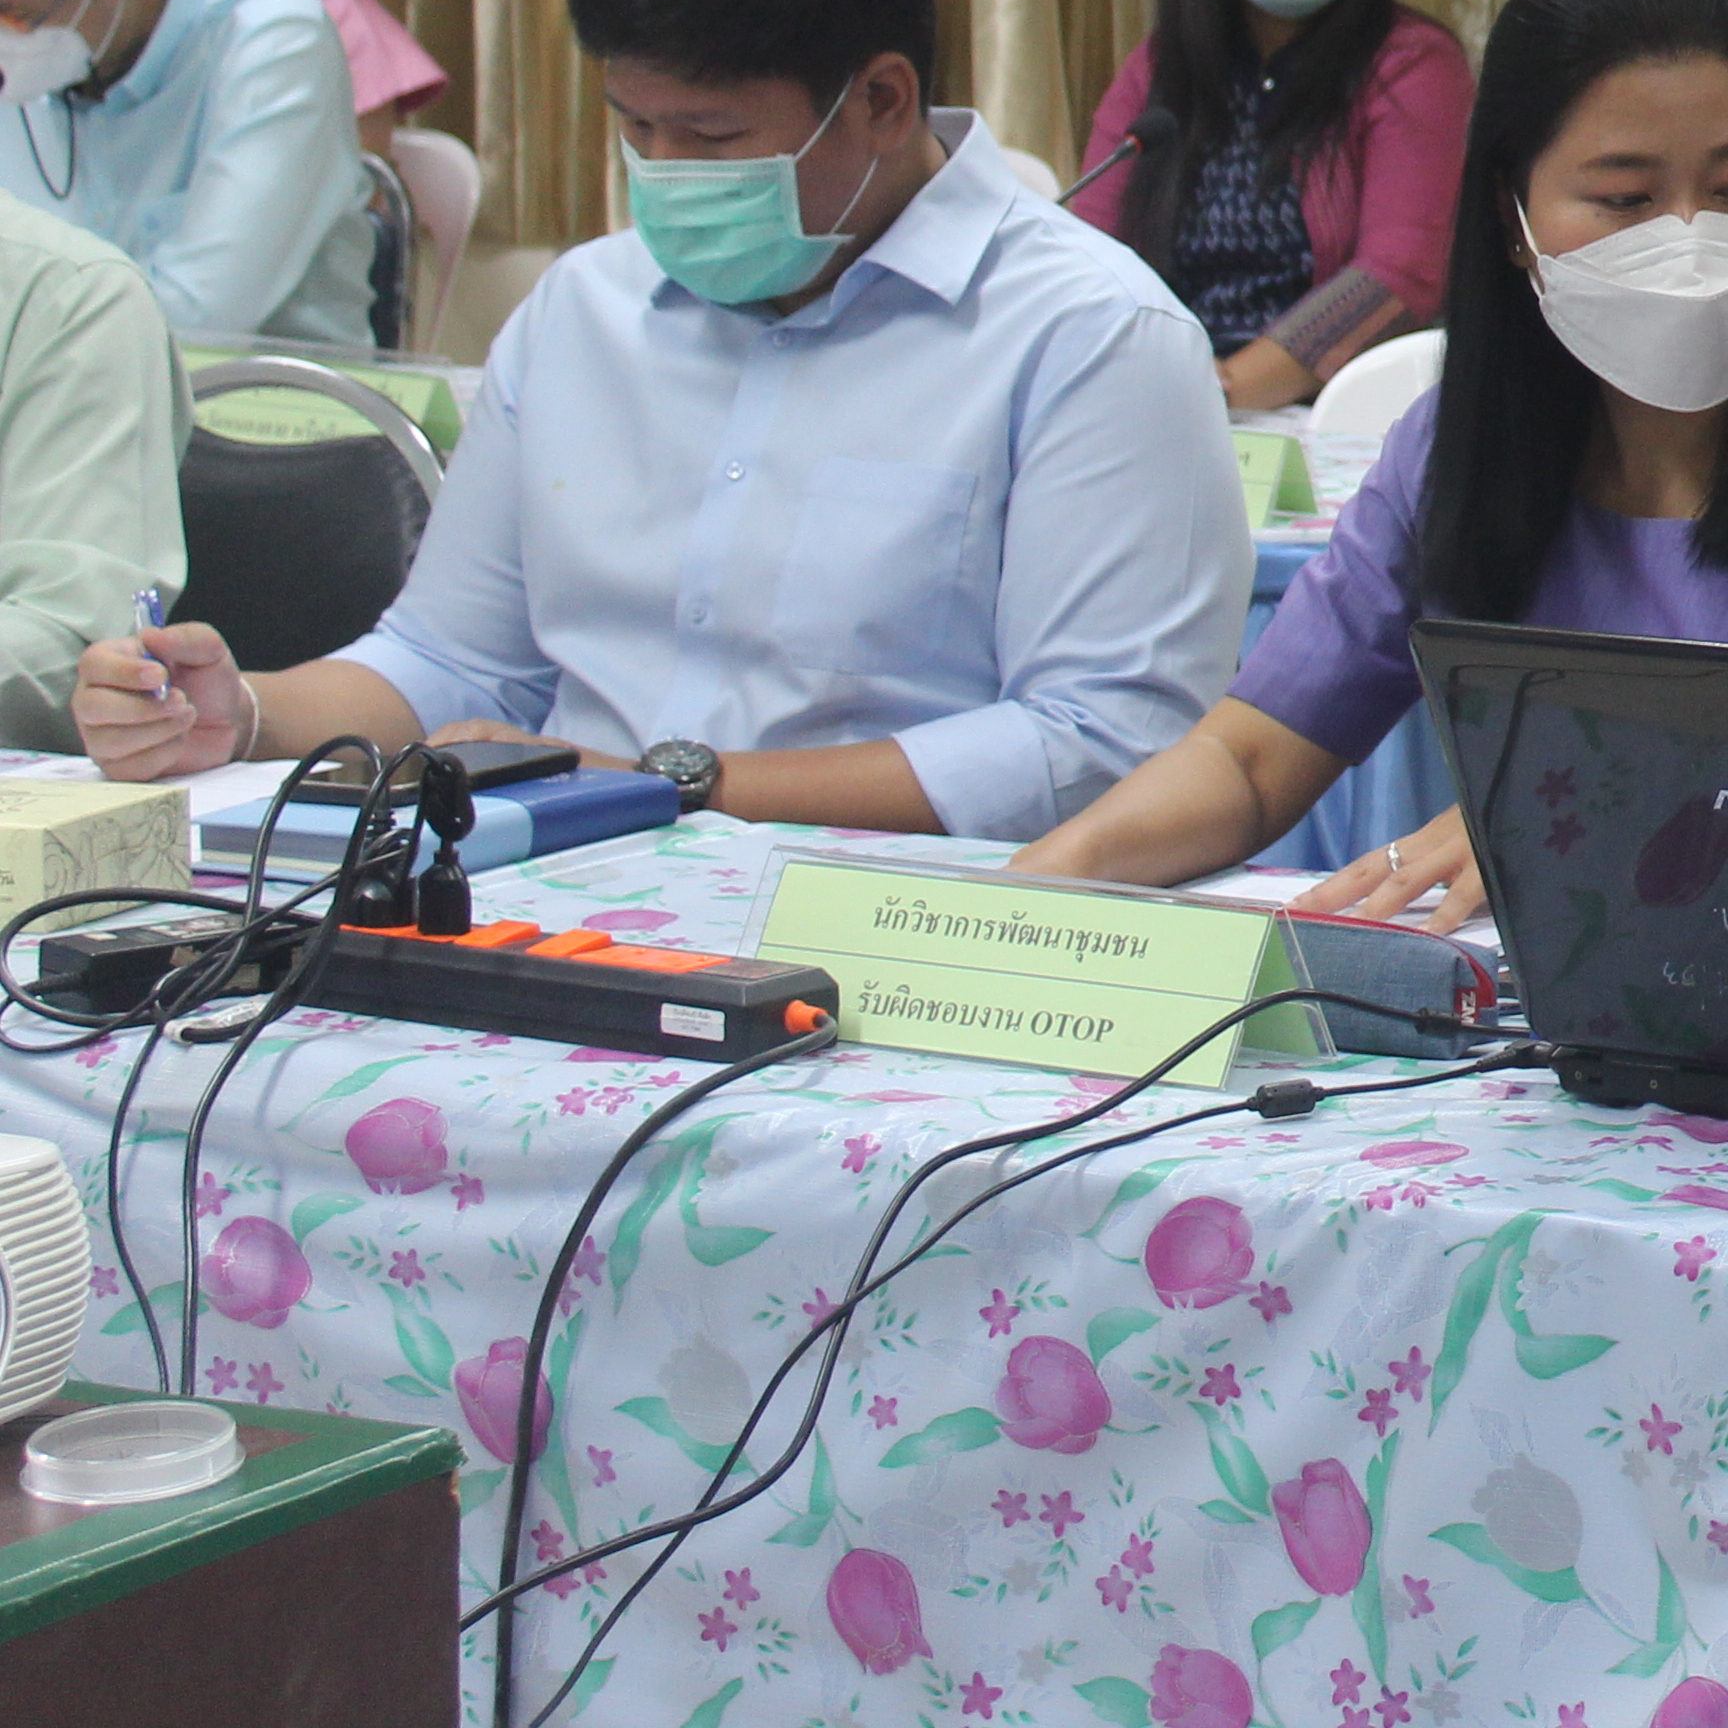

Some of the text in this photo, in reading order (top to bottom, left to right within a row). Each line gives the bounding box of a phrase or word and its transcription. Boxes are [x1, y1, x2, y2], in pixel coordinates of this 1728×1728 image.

[873, 895, 1150, 963] นักวิชาการพัฒนาชุมชน
[857, 979, 1115, 1044] รับผิดชอบงาน OTOP
